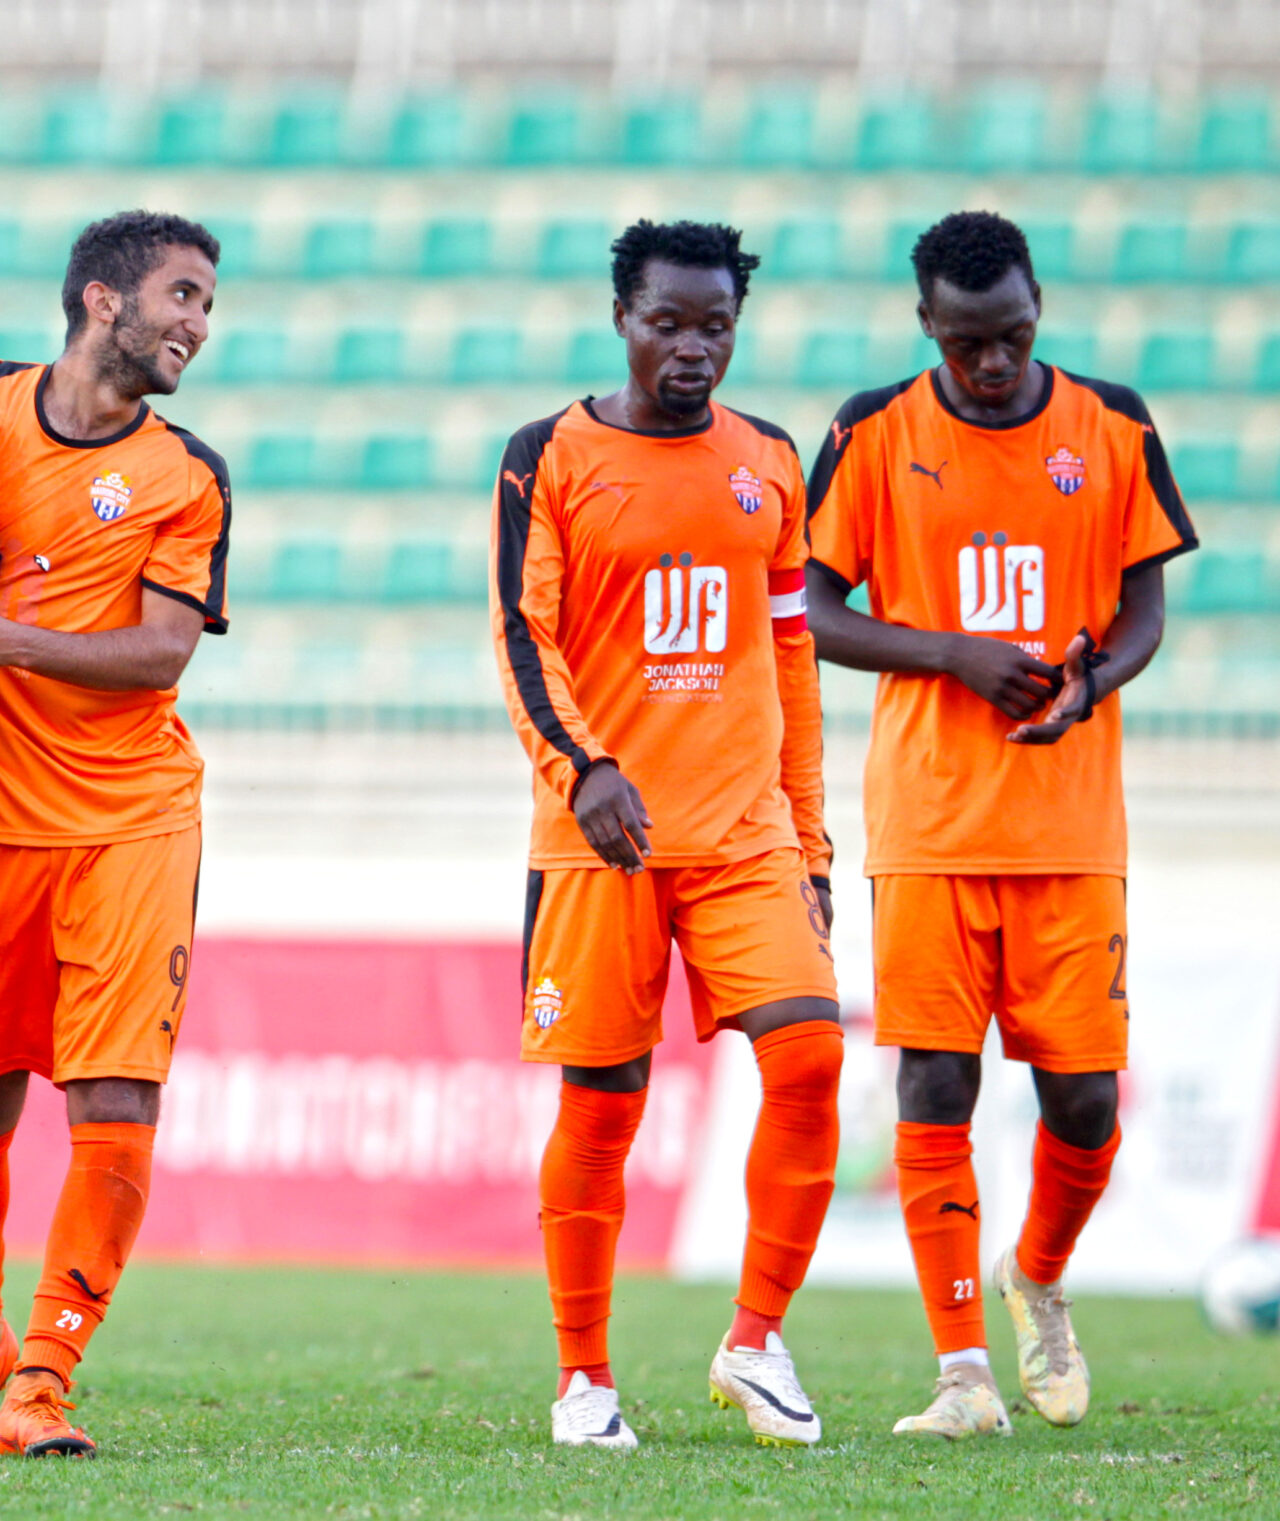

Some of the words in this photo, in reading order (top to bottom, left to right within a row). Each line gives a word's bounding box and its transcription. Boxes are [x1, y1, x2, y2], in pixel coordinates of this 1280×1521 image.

[643, 663, 724, 679] JONATHAN
[648, 677, 719, 691] JACKSON
[169, 945, 188, 1012] 9
[952, 1277, 974, 1301] 22
[55, 1309, 83, 1331] 29
